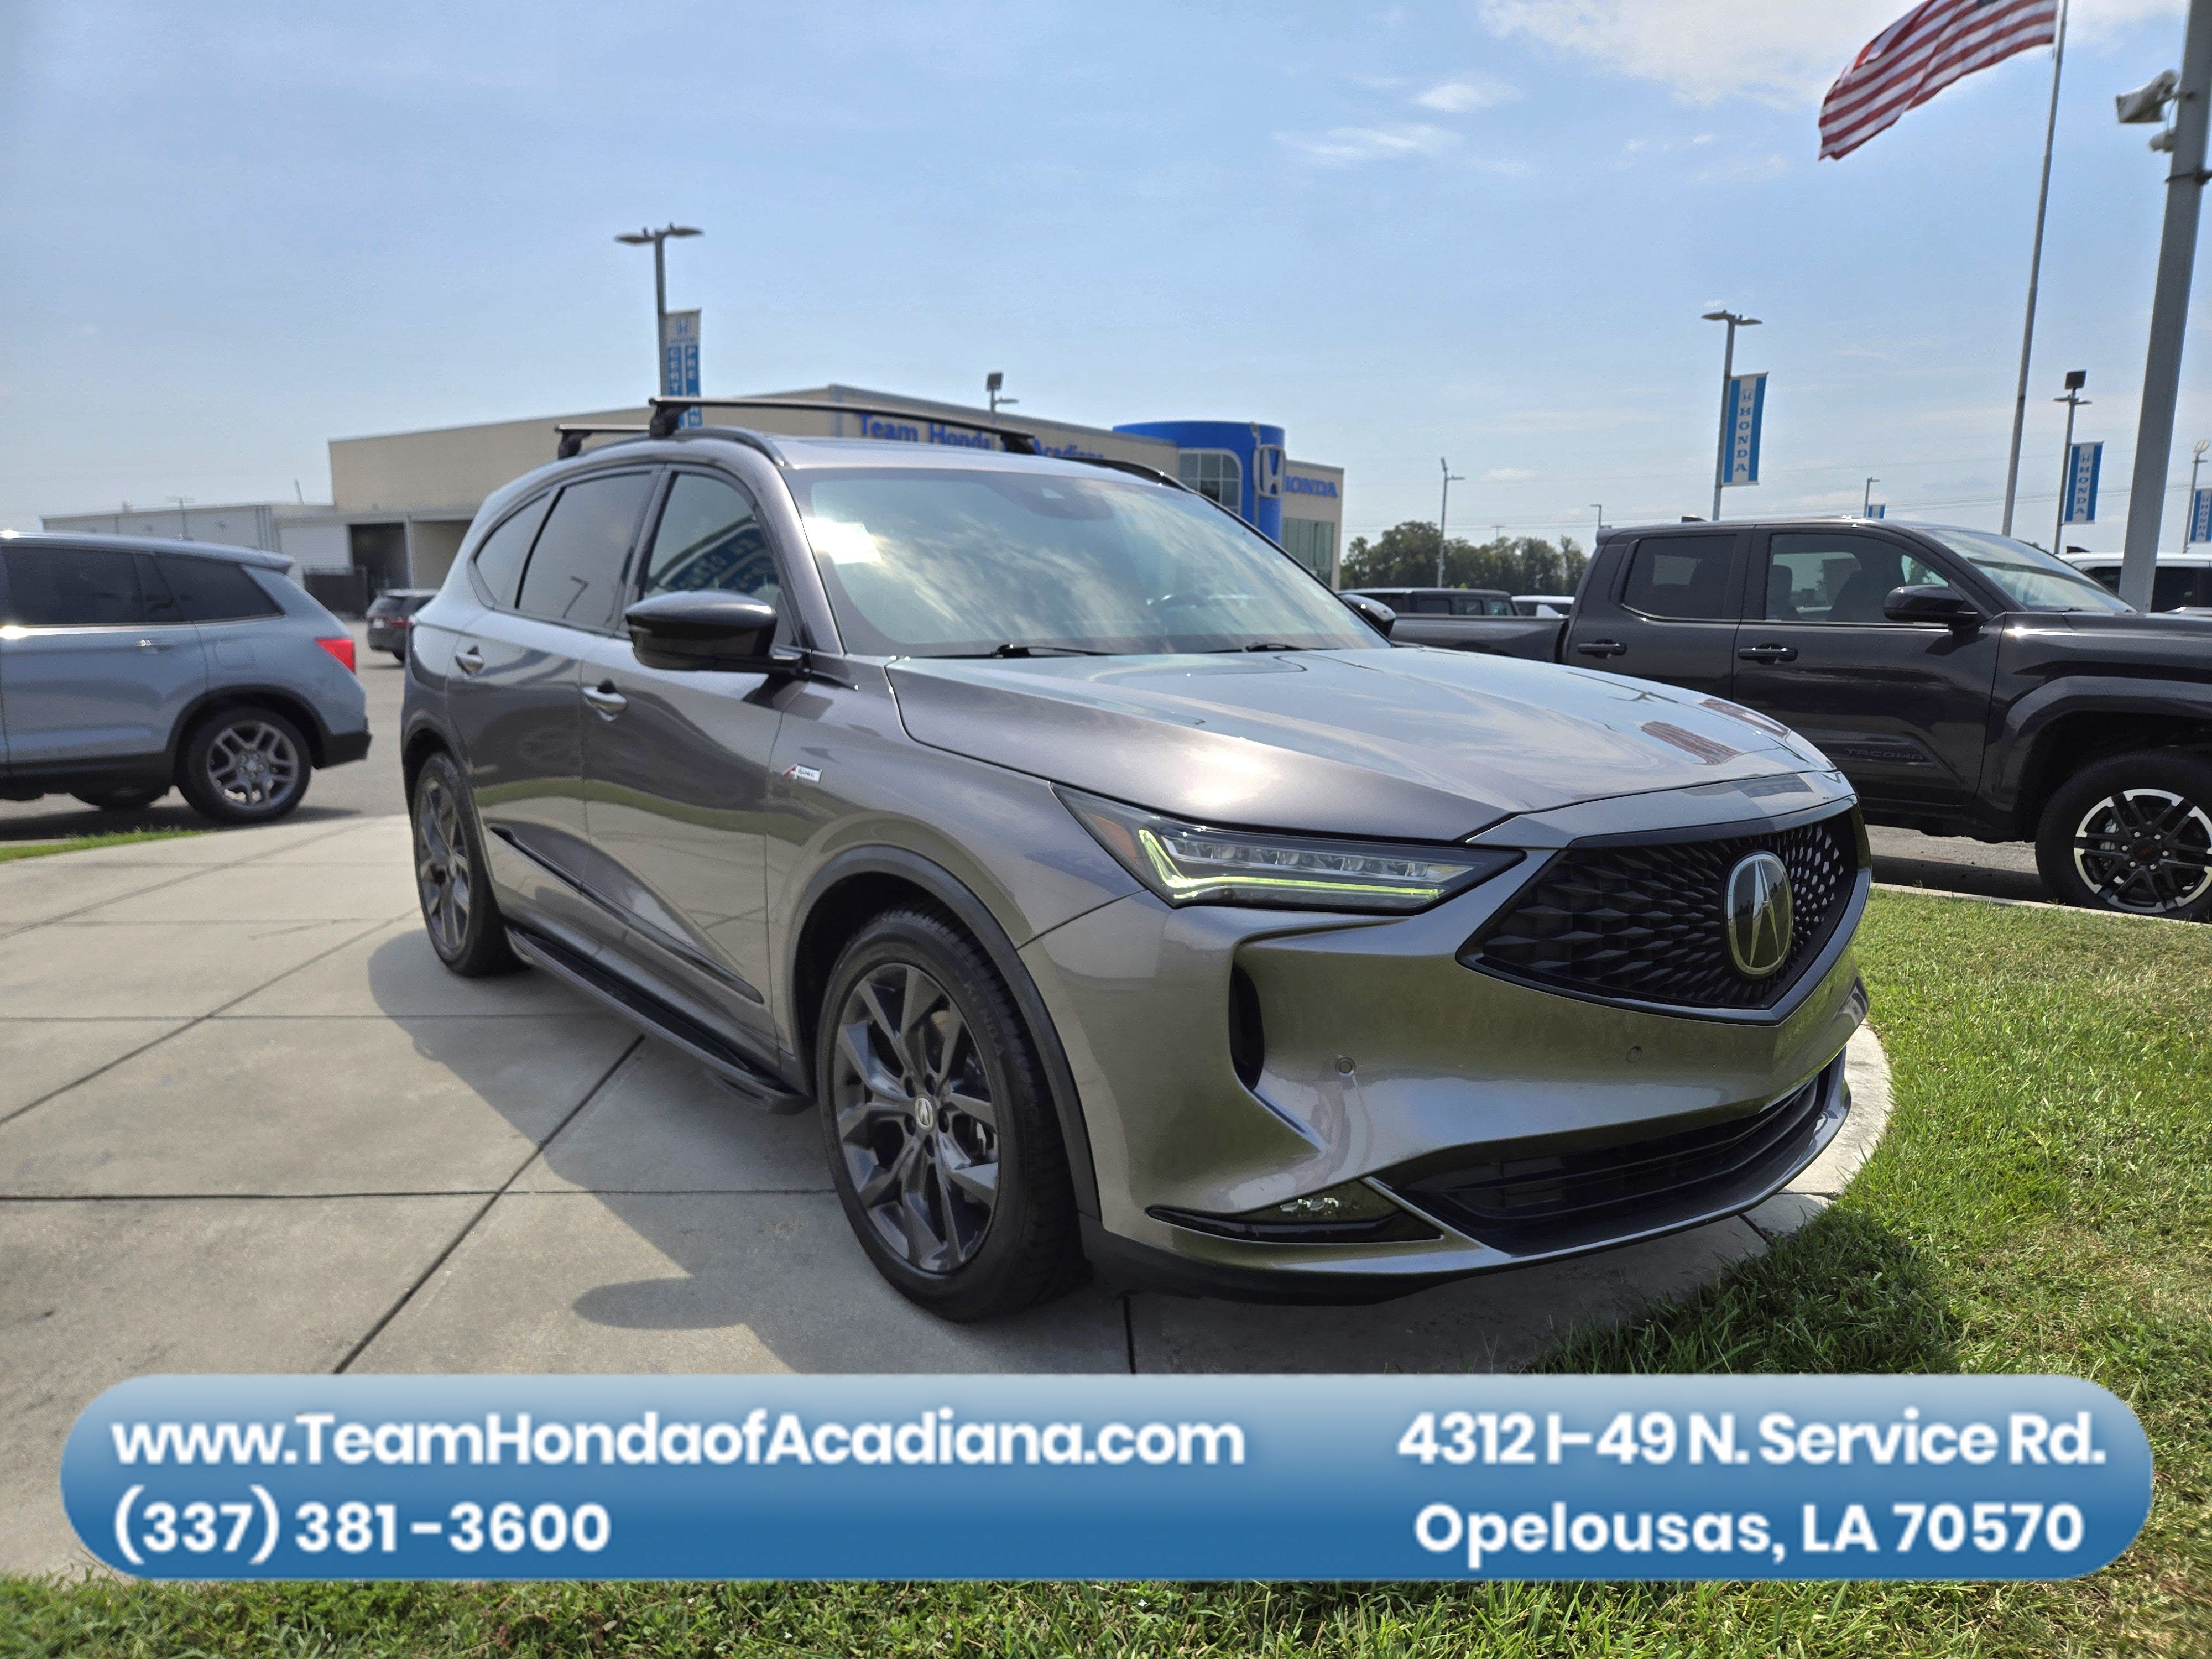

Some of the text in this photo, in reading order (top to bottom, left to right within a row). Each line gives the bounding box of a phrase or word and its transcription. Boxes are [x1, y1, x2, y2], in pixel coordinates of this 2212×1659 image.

[857, 414, 919, 442] Team
[928, 421, 992, 450] Honda
[1735, 407, 1751, 472] HONDA
[2074, 466, 2090, 515] HONDA
[1844, 748, 1924, 760] TACOMA
